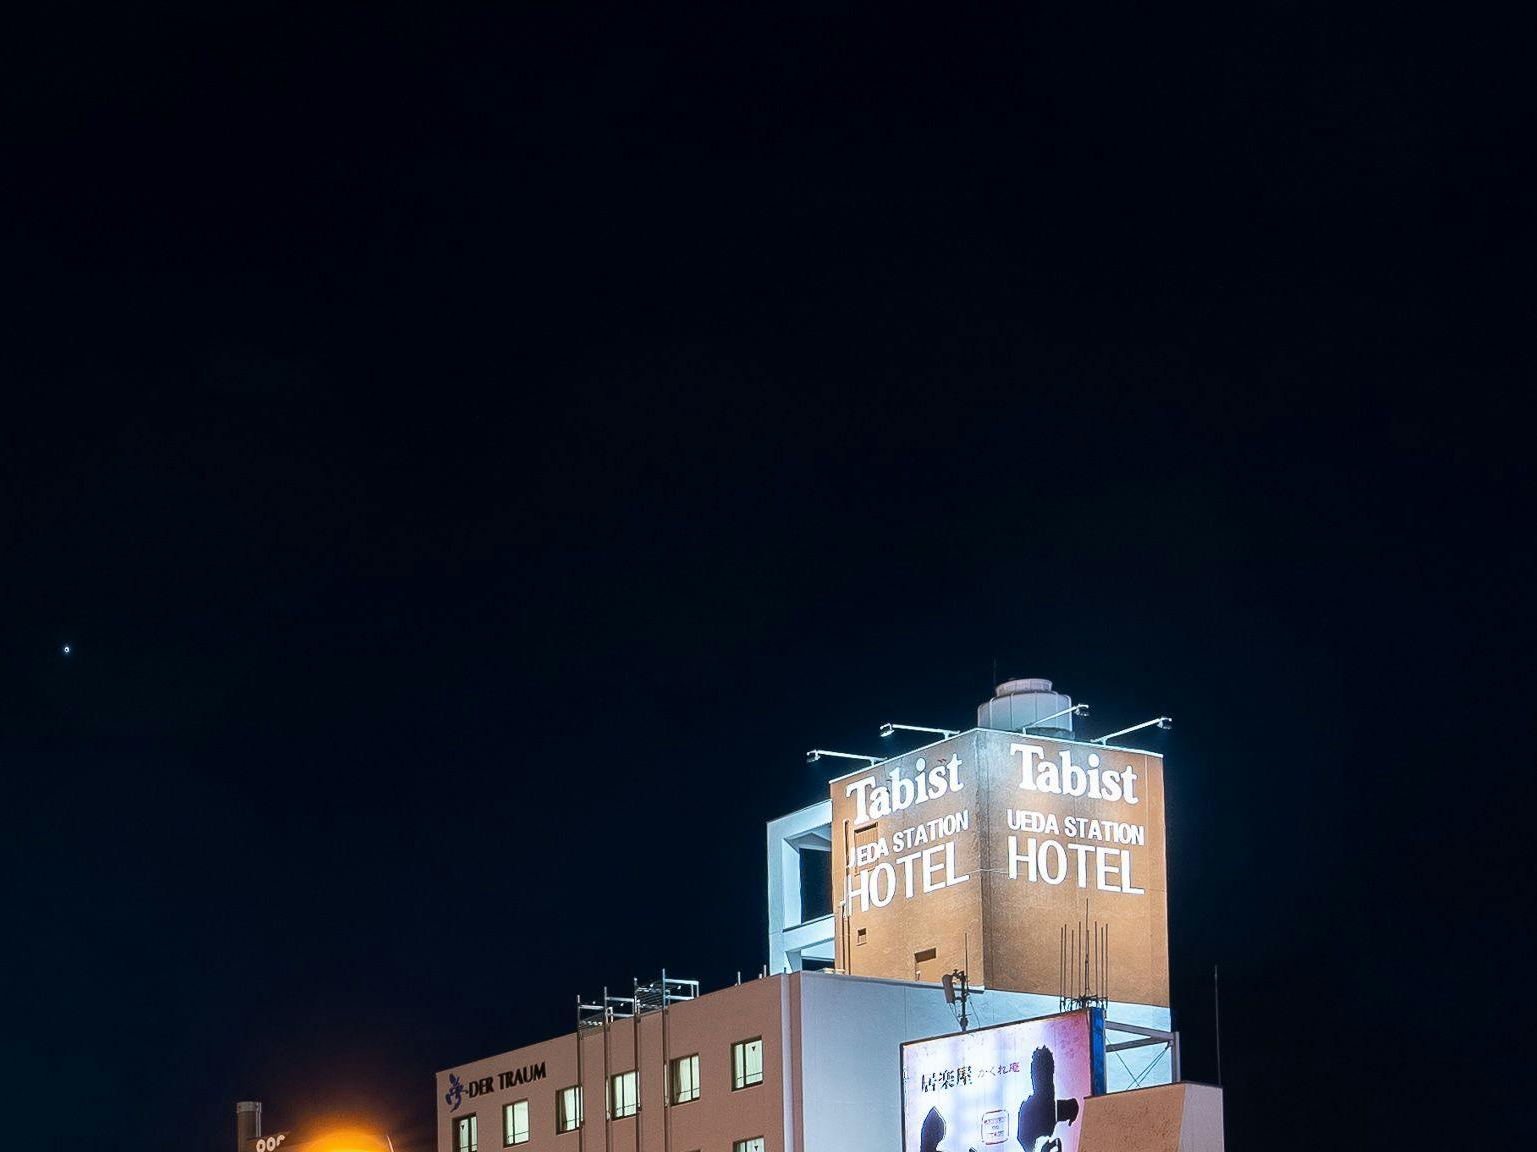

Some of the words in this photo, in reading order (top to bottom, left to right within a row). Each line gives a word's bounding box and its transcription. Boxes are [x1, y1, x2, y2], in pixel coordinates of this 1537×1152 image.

[846, 754, 963, 827] Tabist
[1010, 743, 1139, 805] Tabist
[892, 810, 969, 855] STATION
[1007, 809, 1060, 836] UEDA
[1064, 818, 1144, 846] STATION
[845, 841, 970, 917] HOTEL
[1007, 836, 1144, 895] HOTEL
[469, 1077, 494, 1098] DER
[498, 1062, 547, 1090] TRAUM
